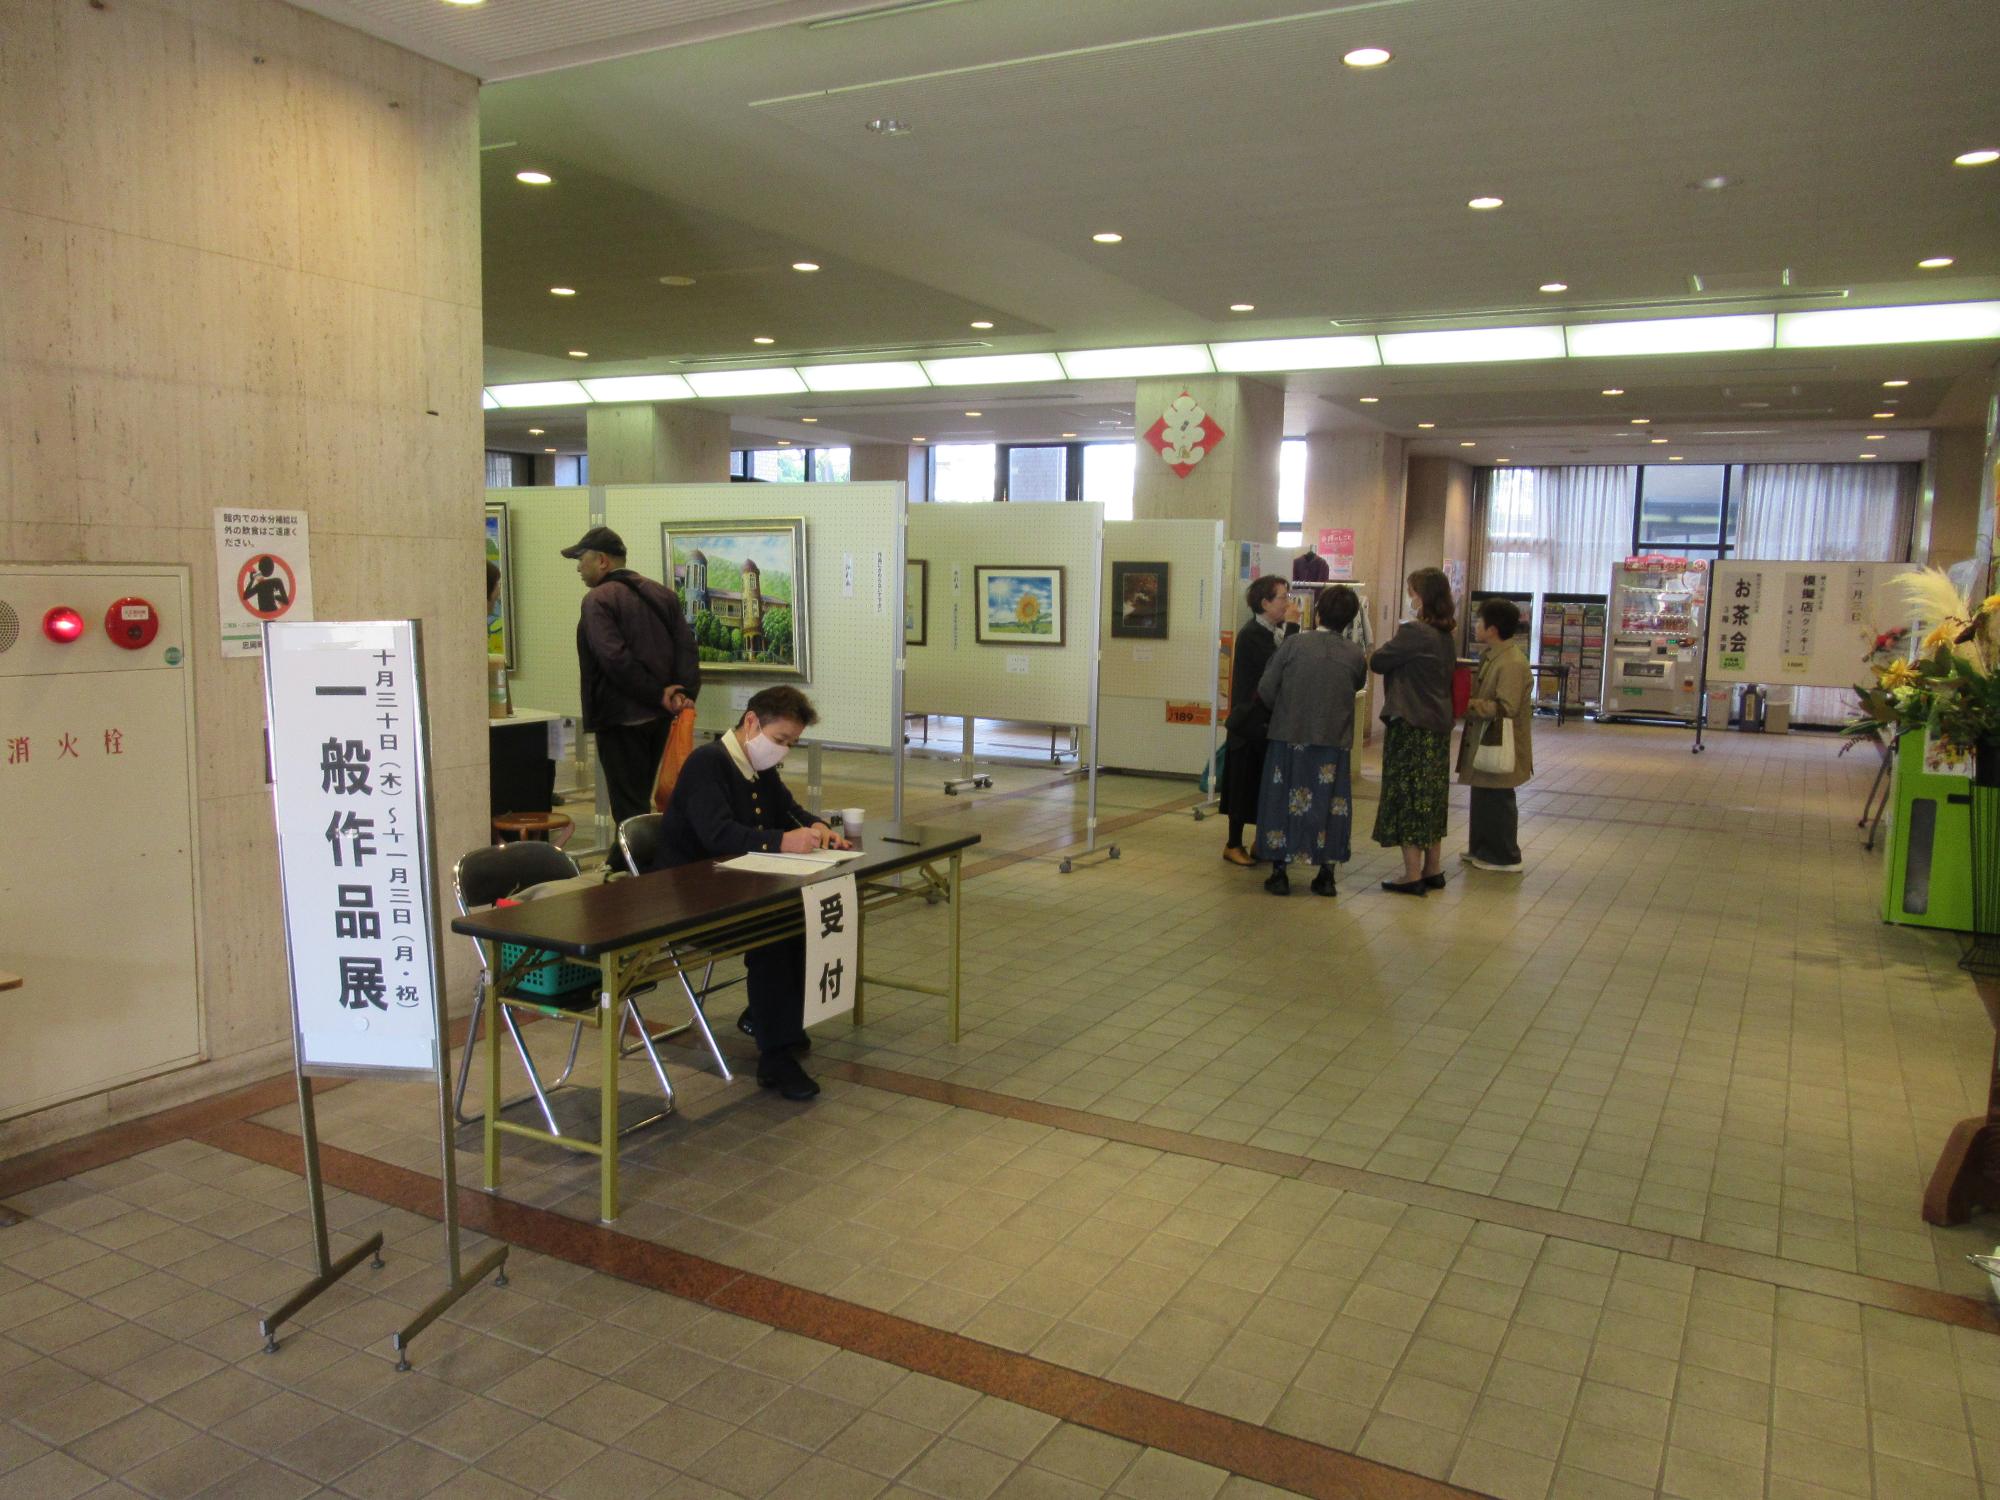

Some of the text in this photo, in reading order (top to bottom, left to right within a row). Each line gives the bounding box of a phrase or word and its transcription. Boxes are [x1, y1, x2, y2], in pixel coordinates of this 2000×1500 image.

[1730, 577, 1752, 652] お茶会
[7, 728, 124, 765] 消火栓
[315, 686, 389, 1011] 一般作品展
[819, 892, 844, 1004] 受付
